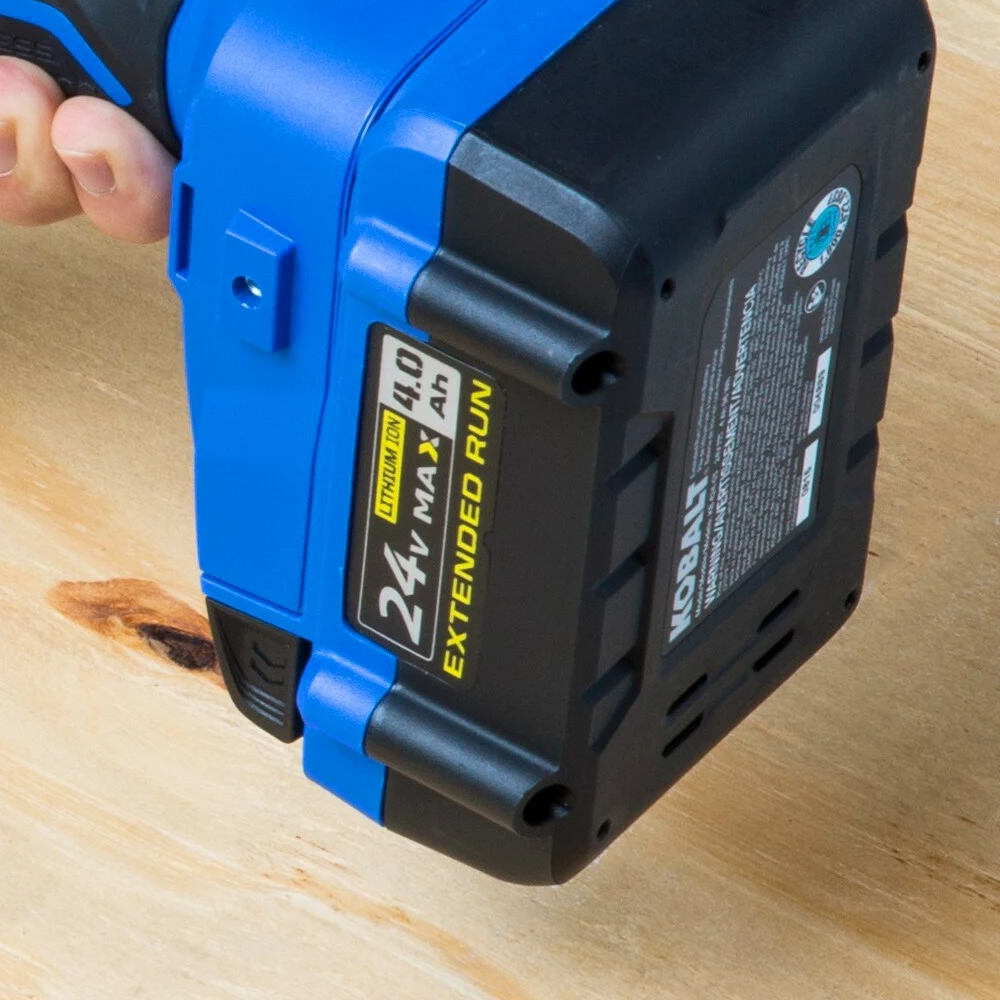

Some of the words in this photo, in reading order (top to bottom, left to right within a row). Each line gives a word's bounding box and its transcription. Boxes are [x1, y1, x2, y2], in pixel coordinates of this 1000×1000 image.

[392, 347, 424, 412] 4.0
[429, 373, 449, 421] Ah
[387, 415, 401, 447] ION
[378, 451, 398, 517] LITHIUM
[412, 428, 441, 525] MAX
[442, 472, 483, 680] EXTENDED
[465, 378, 493, 466] RUN
[668, 474, 709, 643] KOBALT
